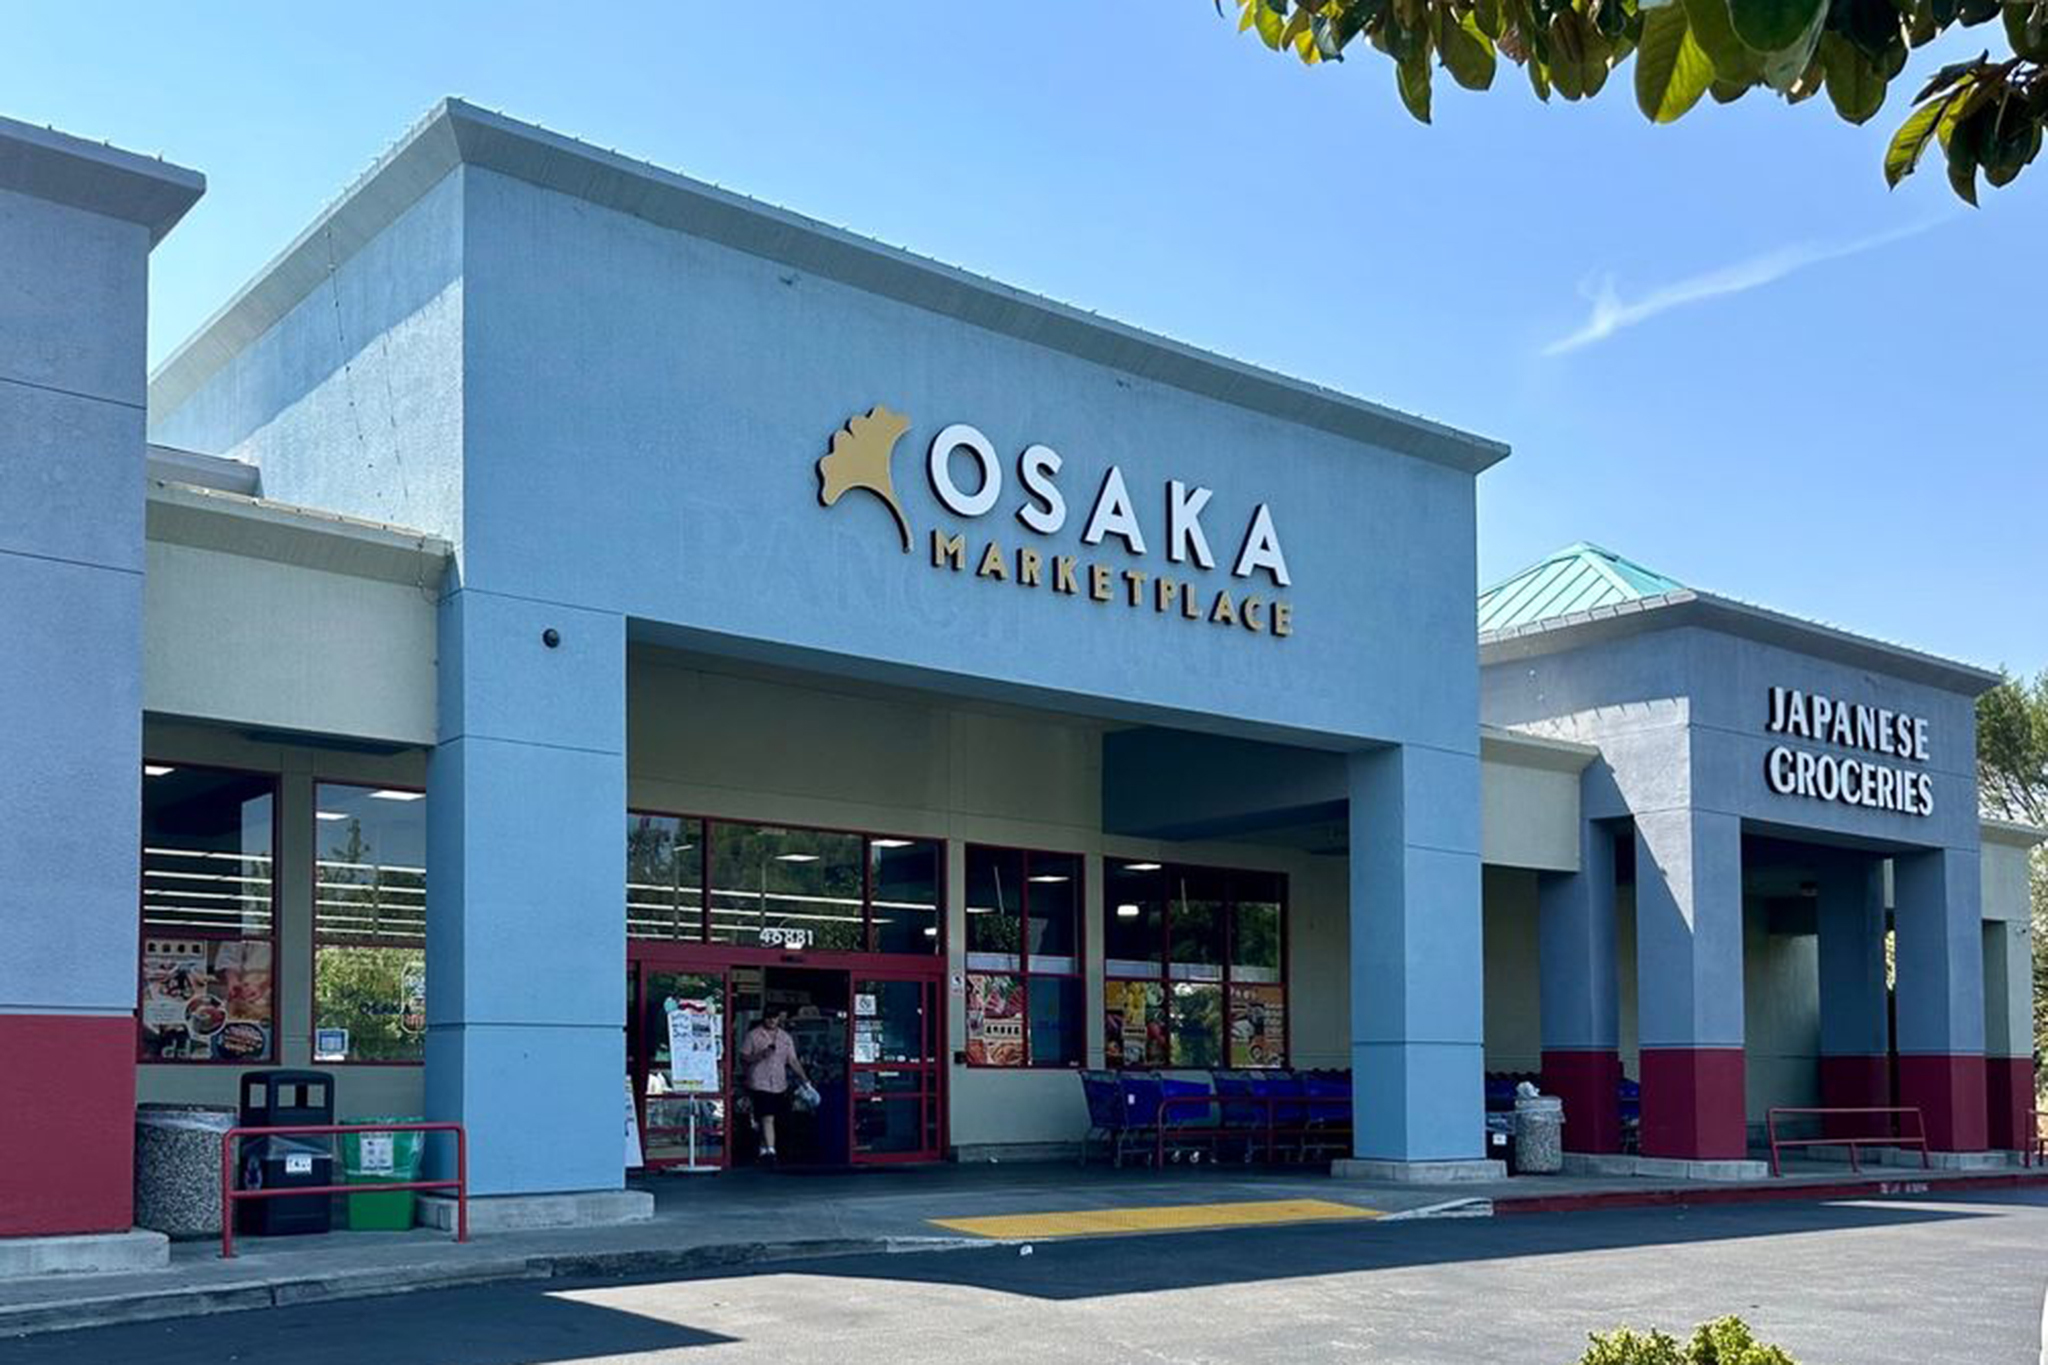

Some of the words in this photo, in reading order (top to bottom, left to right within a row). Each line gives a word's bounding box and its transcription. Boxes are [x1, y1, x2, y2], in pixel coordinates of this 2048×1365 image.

[927, 424, 1291, 586] OSAKA
[931, 529, 1293, 637] MARKETPLACE
[1766, 686, 1930, 760] JAPANESE
[1765, 746, 1934, 817] GROCERIES
